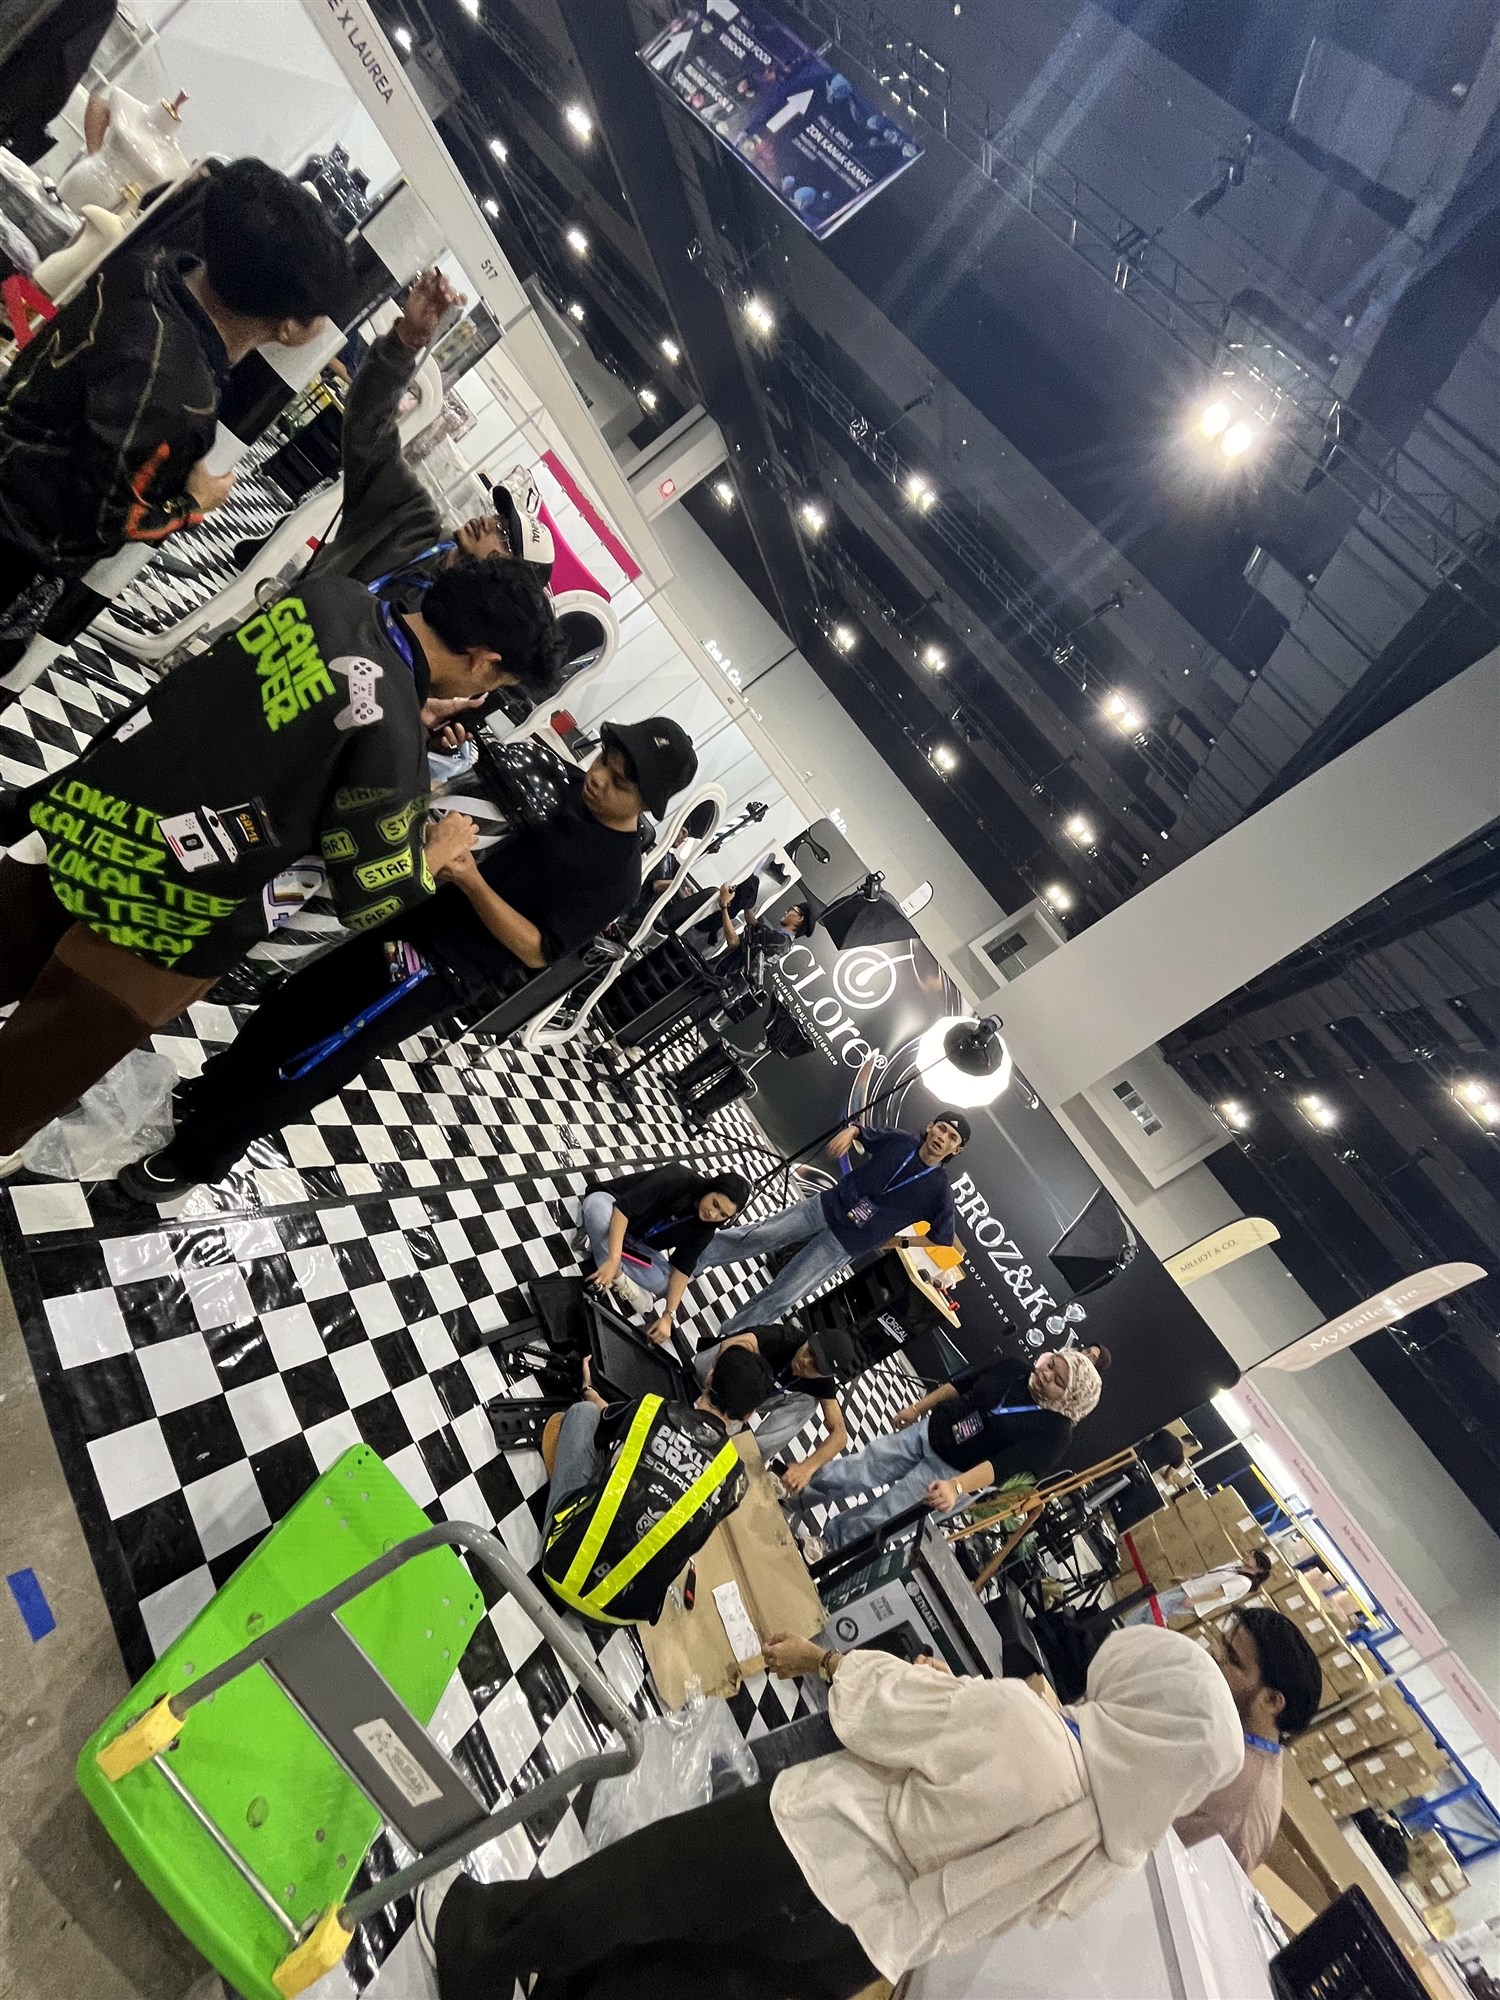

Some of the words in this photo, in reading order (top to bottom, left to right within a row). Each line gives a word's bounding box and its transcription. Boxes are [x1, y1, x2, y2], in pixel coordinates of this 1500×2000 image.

[337, 12, 354, 30] X
[348, 28, 394, 104] LAUREA
[805, 123, 825, 142] ZON
[820, 137, 873, 188] KANAK-KANAK
[480, 259, 498, 281] 517
[236, 614, 301, 732] OVER
[268, 597, 337, 711] GAME
[50, 777, 132, 829] LOKAL
[48, 843, 157, 900] LOKAL
[364, 855, 411, 884] STAR
[101, 896, 213, 936] TEEZ
[772, 972, 794, 1002] Reclaim
[794, 1002, 807, 1021] Your
[806, 1022, 838, 1066] Confidence
[1180, 1250, 1212, 1273] MILLIOT
[1214, 1247, 1221, 1255] &
[1310, 1328, 1340, 1352] My
